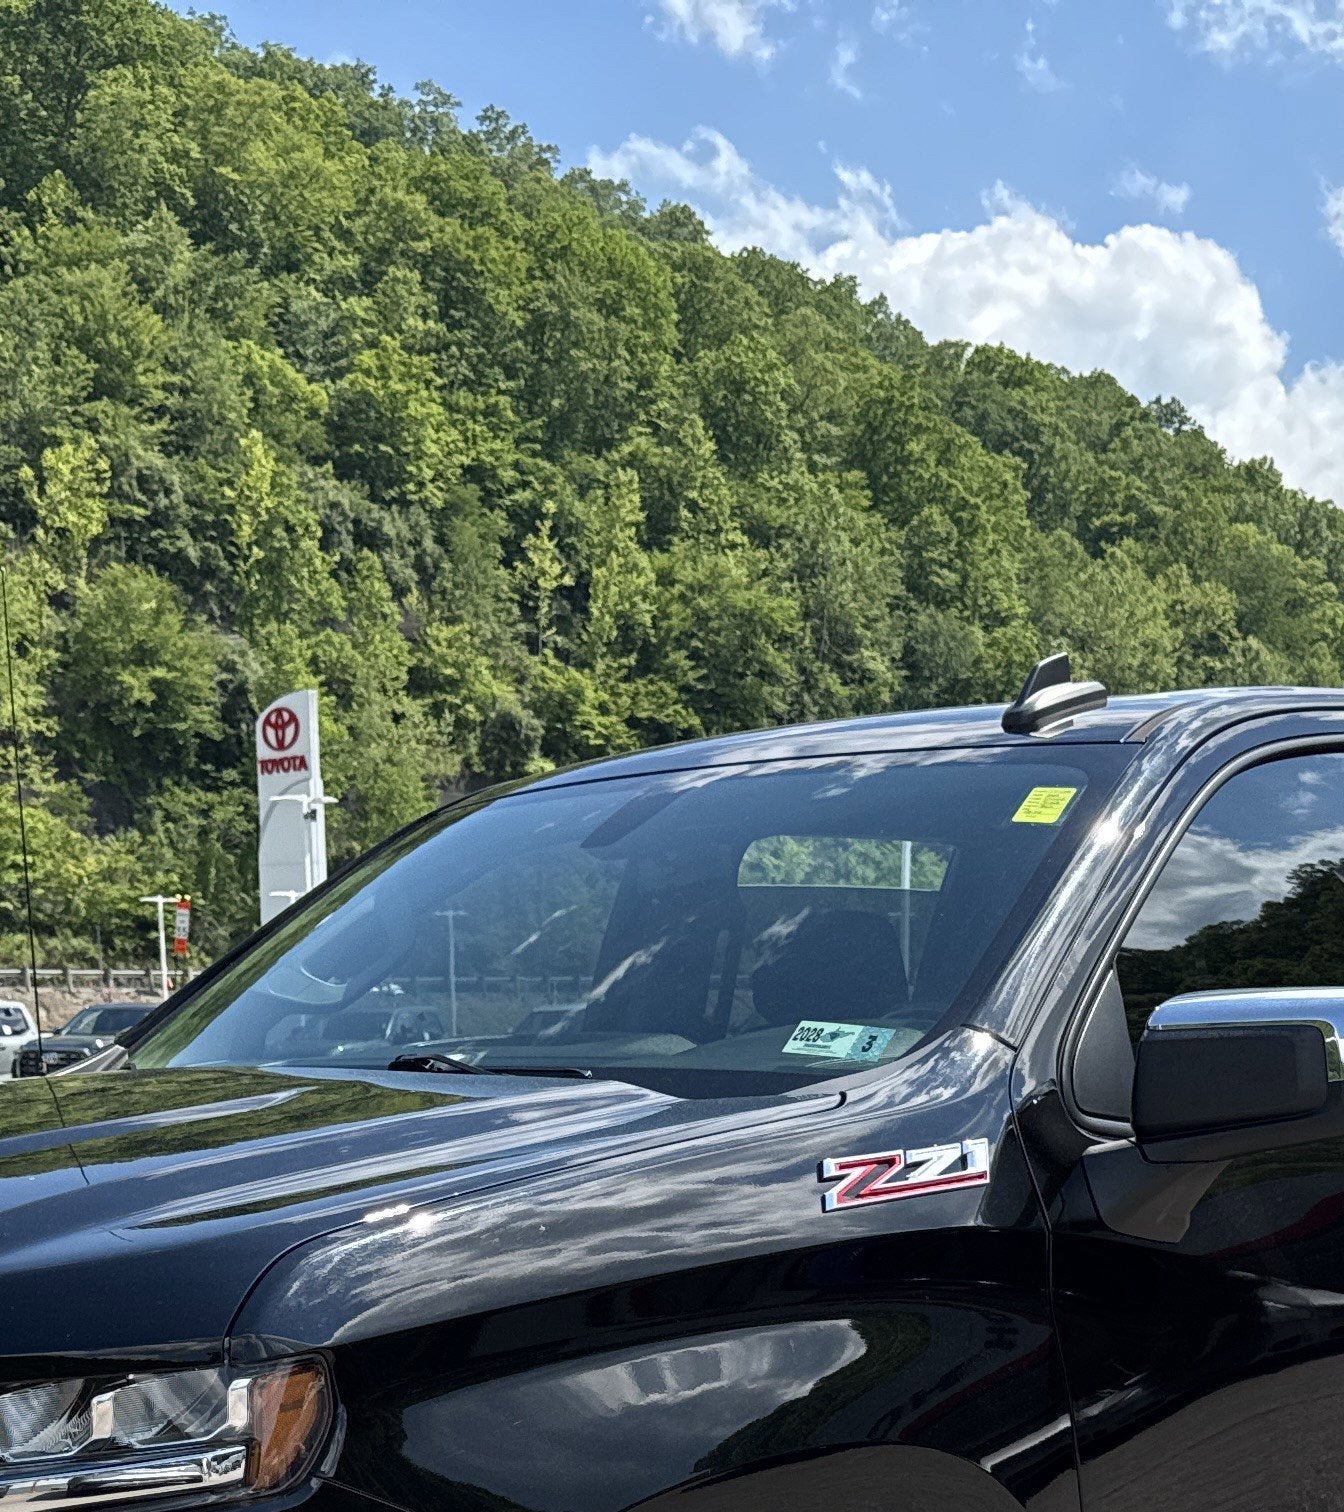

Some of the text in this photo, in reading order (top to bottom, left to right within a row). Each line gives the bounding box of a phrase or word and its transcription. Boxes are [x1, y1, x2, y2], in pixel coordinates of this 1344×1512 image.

[259, 755, 308, 775] TOYOTA
[792, 1026, 824, 1043] 2028
[861, 1034, 879, 1053] 3
[816, 1137, 990, 1213] Z71
